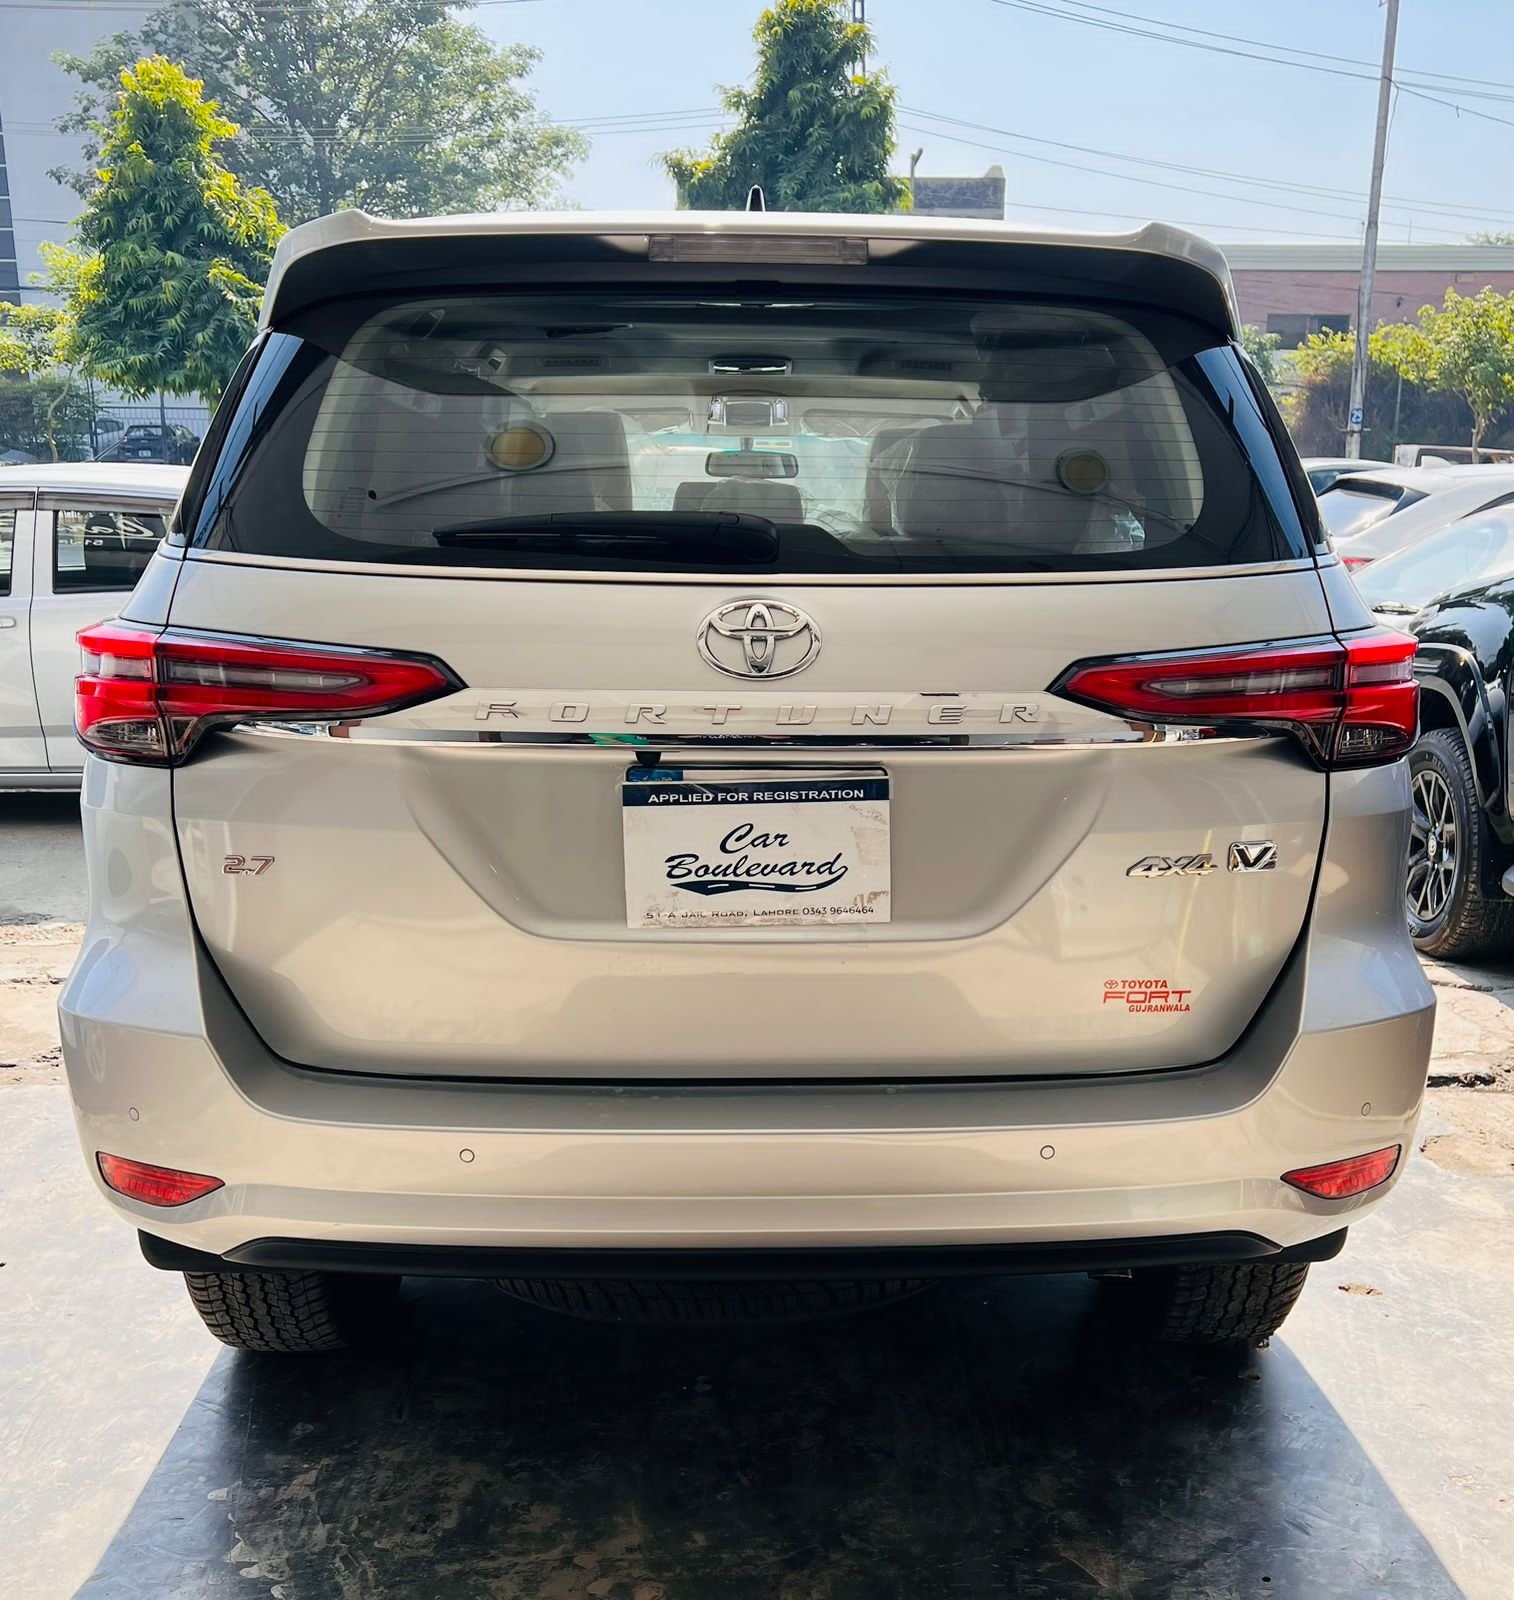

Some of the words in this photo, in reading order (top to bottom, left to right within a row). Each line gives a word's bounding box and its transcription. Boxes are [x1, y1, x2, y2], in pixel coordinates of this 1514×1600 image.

[474, 702, 1040, 725] FORTUNER
[648, 793, 714, 803] APPLIED
[718, 792, 749, 802] FOR
[753, 789, 864, 801] REGISTRATION
[719, 822, 791, 854] Car
[222, 854, 275, 876] 2.7
[664, 852, 848, 879] Boulevard
[802, 907, 828, 916] 0343
[1121, 980, 1168, 989] TOYOTA
[1103, 990, 1192, 1003] FORT
[1128, 1003, 1190, 1013] GUJRANWALA
